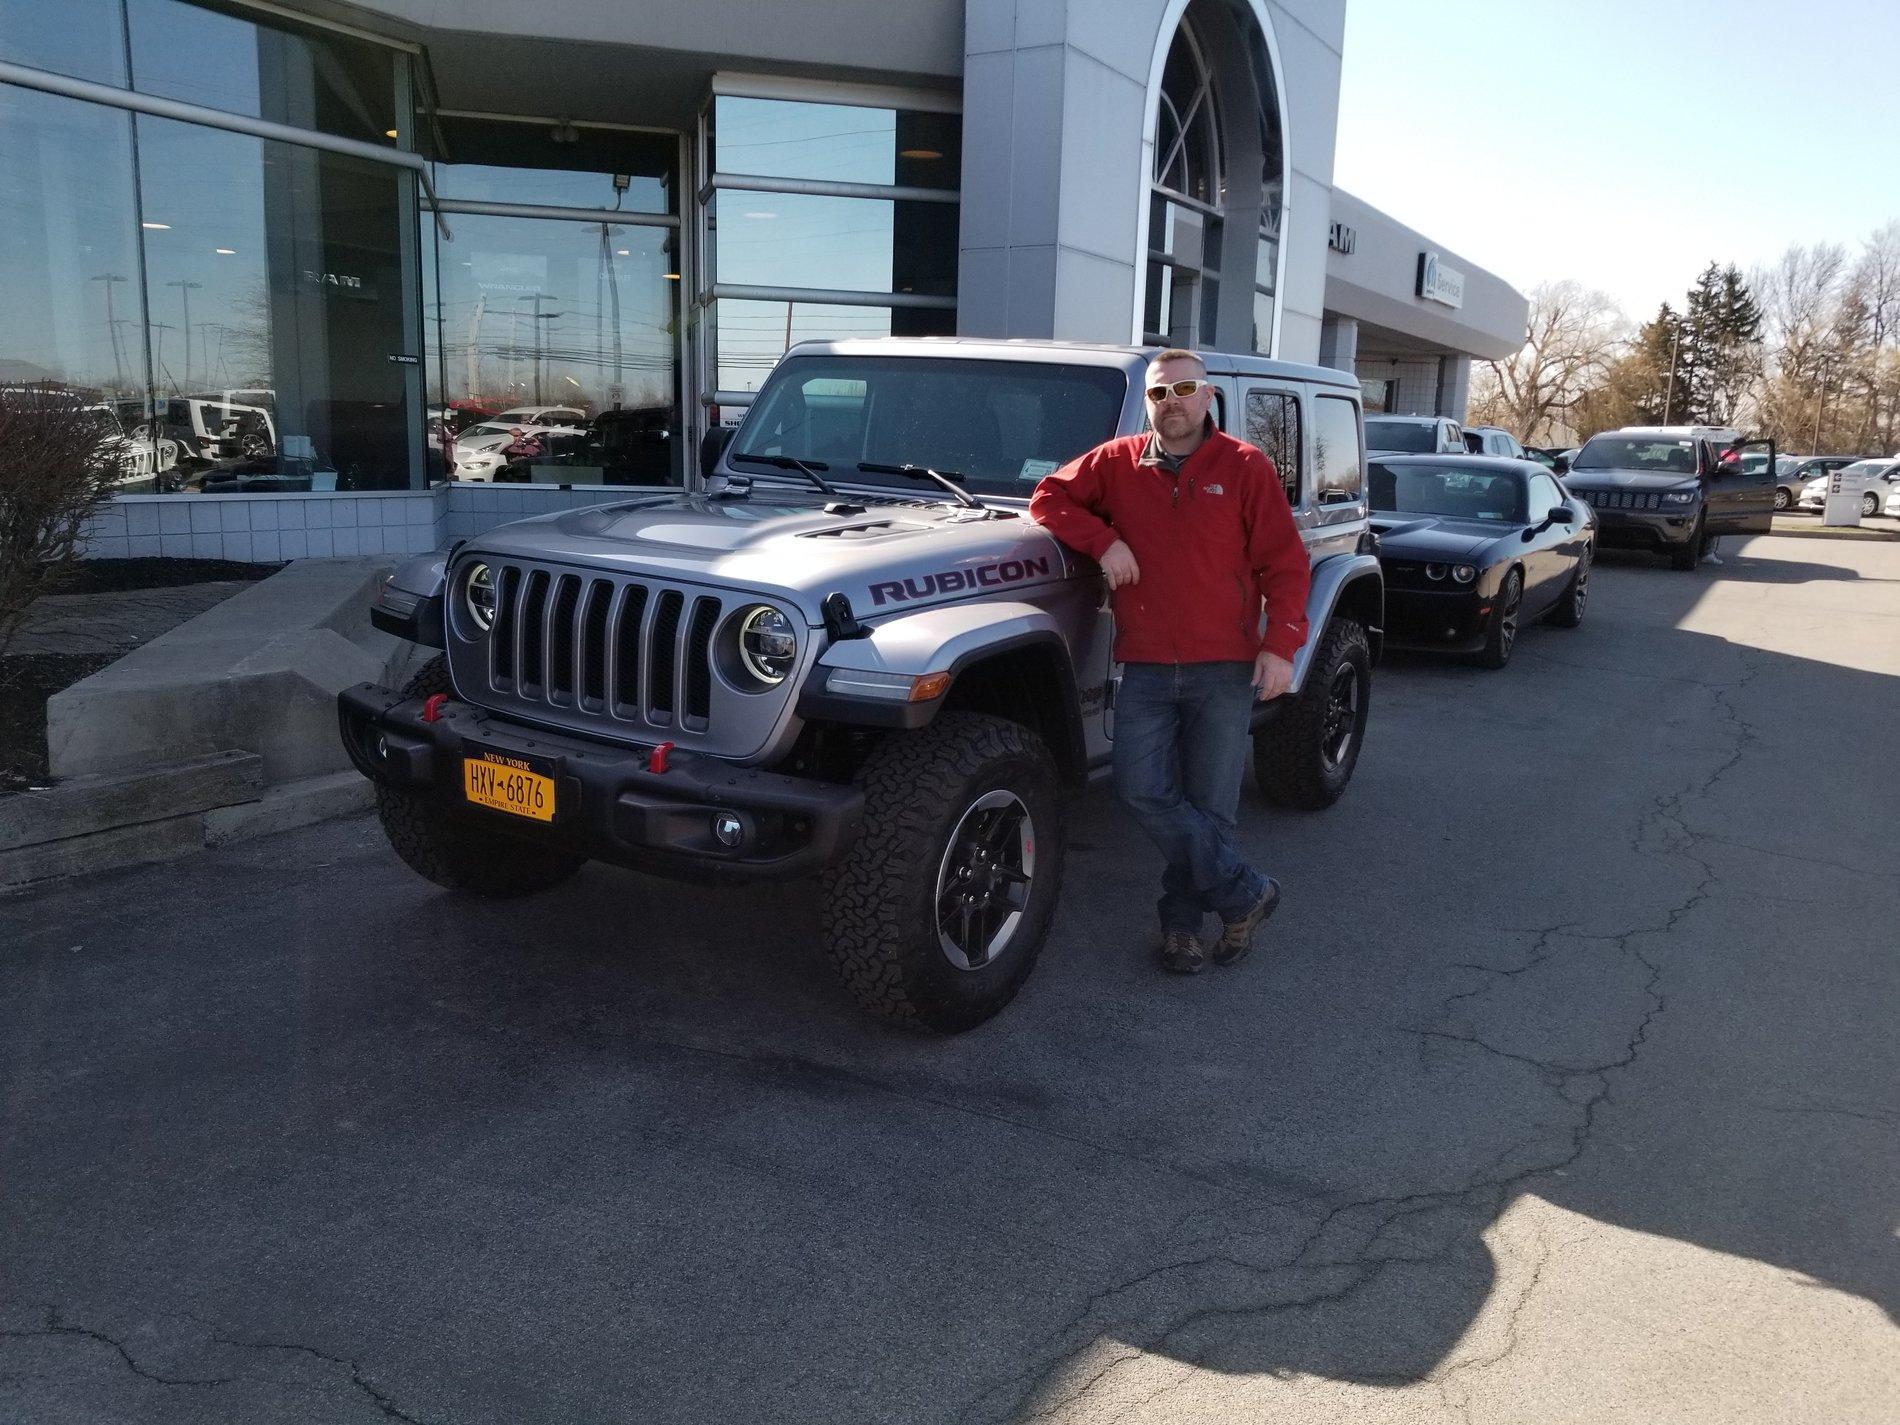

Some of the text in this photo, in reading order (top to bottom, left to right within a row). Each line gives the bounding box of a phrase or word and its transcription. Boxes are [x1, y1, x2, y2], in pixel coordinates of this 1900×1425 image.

[303, 270, 361, 288] RAM
[1438, 272, 1460, 298] Service
[868, 556, 1050, 606] RUBICON
[484, 752, 530, 771] NEW YORK
[485, 797, 531, 815] EMPIRE STATE
